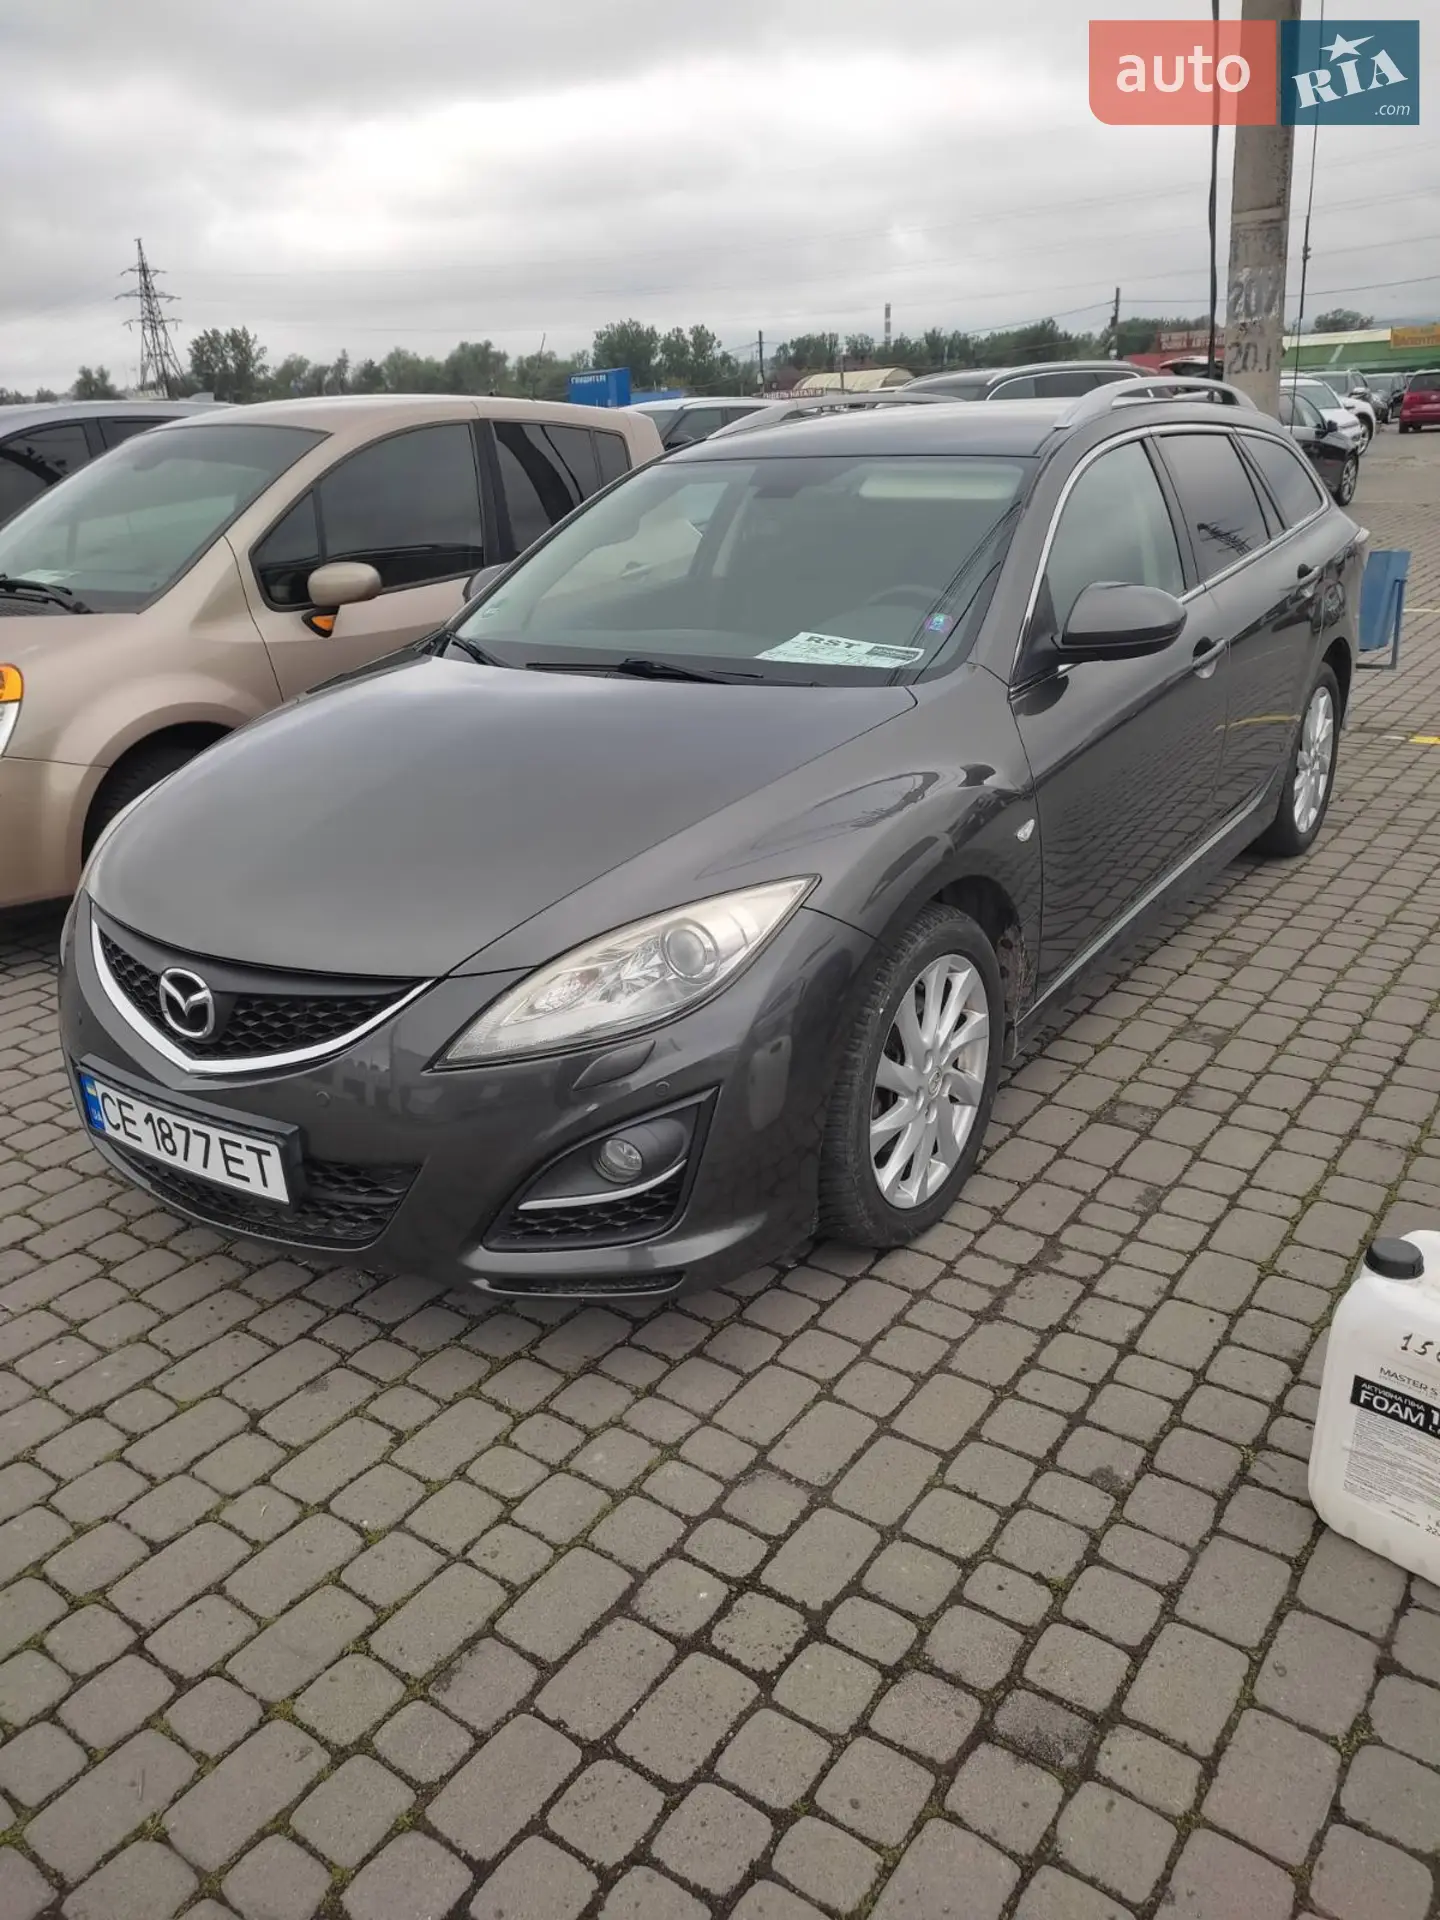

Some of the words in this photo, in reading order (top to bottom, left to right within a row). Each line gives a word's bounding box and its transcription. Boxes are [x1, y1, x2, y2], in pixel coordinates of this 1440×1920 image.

[805, 635, 862, 649] RST
[101, 1092, 142, 1142] CE
[144, 1112, 211, 1169] 1877
[218, 1137, 272, 1188] ET
[1379, 1366, 1428, 1391] MASTER
[1360, 1389, 1425, 1427] FOAM
